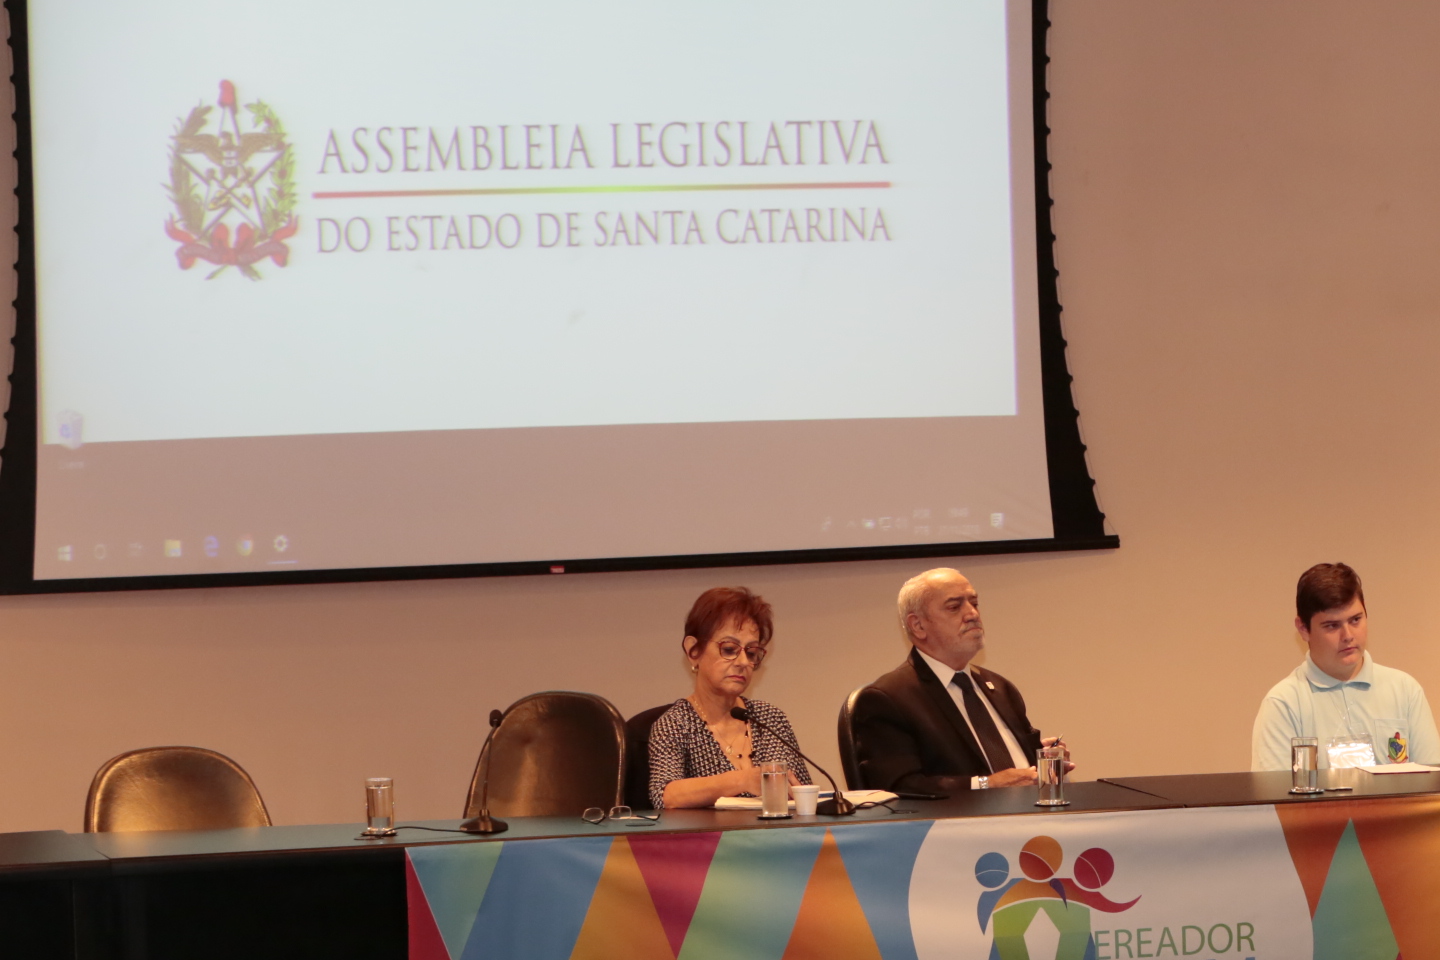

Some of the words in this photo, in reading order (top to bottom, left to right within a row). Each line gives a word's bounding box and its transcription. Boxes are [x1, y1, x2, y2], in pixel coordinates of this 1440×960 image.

[316, 124, 595, 174] ASSEMBLEIA
[609, 119, 890, 169] LEGISLATIVA
[316, 216, 371, 254] DO
[386, 212, 523, 252] ESTADO
[536, 211, 580, 248] DE
[594, 209, 702, 247] SANTA
[716, 207, 892, 245] CATARINA
